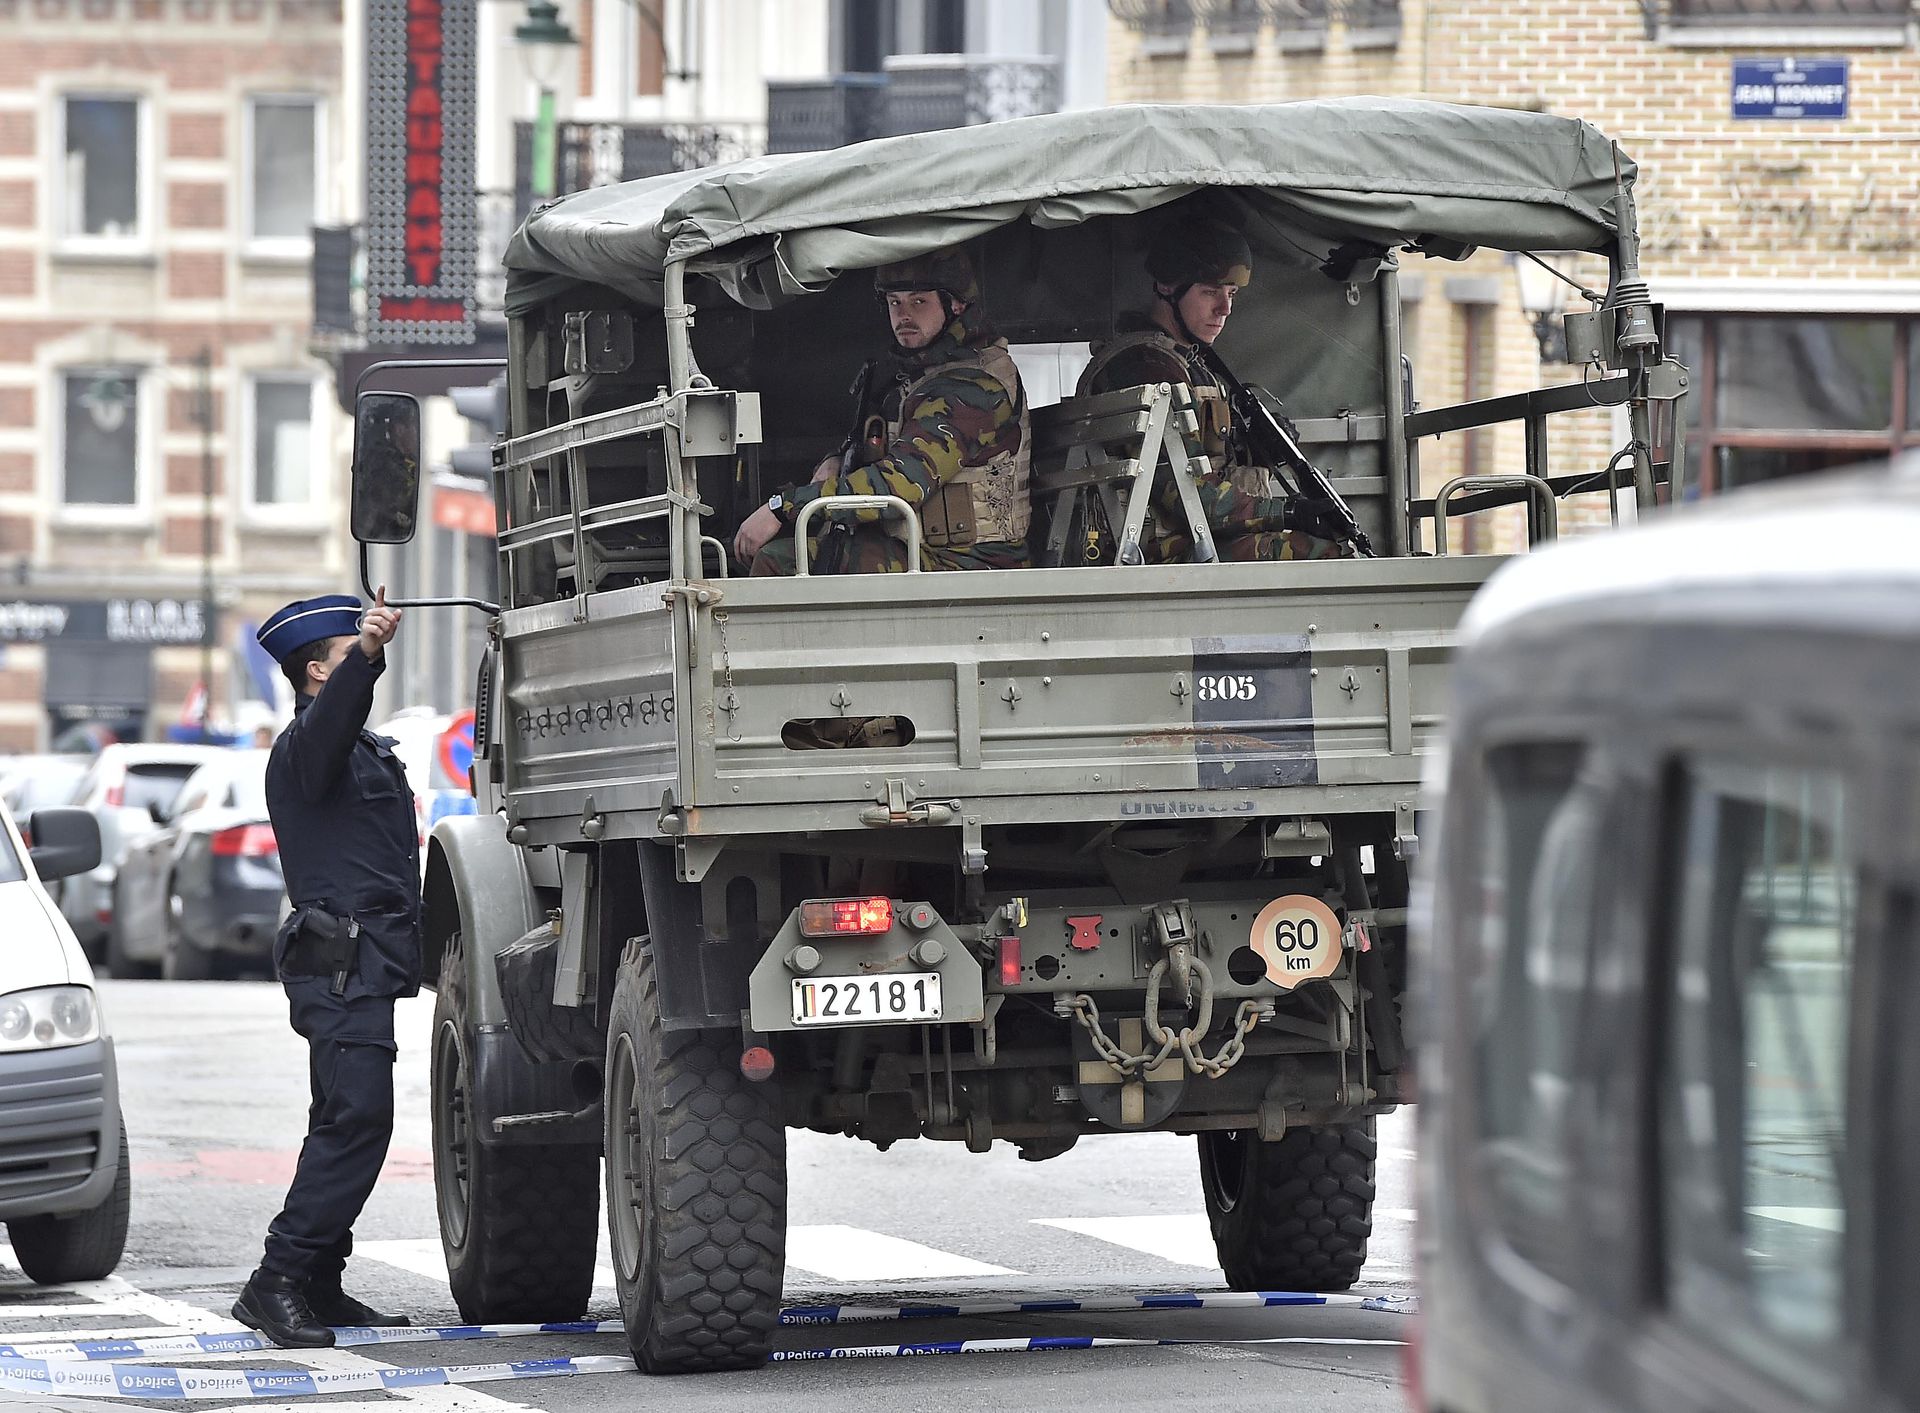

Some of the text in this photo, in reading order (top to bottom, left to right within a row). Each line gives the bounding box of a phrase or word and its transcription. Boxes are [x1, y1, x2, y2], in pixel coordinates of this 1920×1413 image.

[1734, 84, 1845, 105] JEAN MONNET
[1198, 675, 1257, 701] 805
[1275, 918, 1318, 953] 60
[1286, 955, 1311, 971] km
[821, 979, 926, 1017] 22181
[787, 1350, 826, 1361] Police
